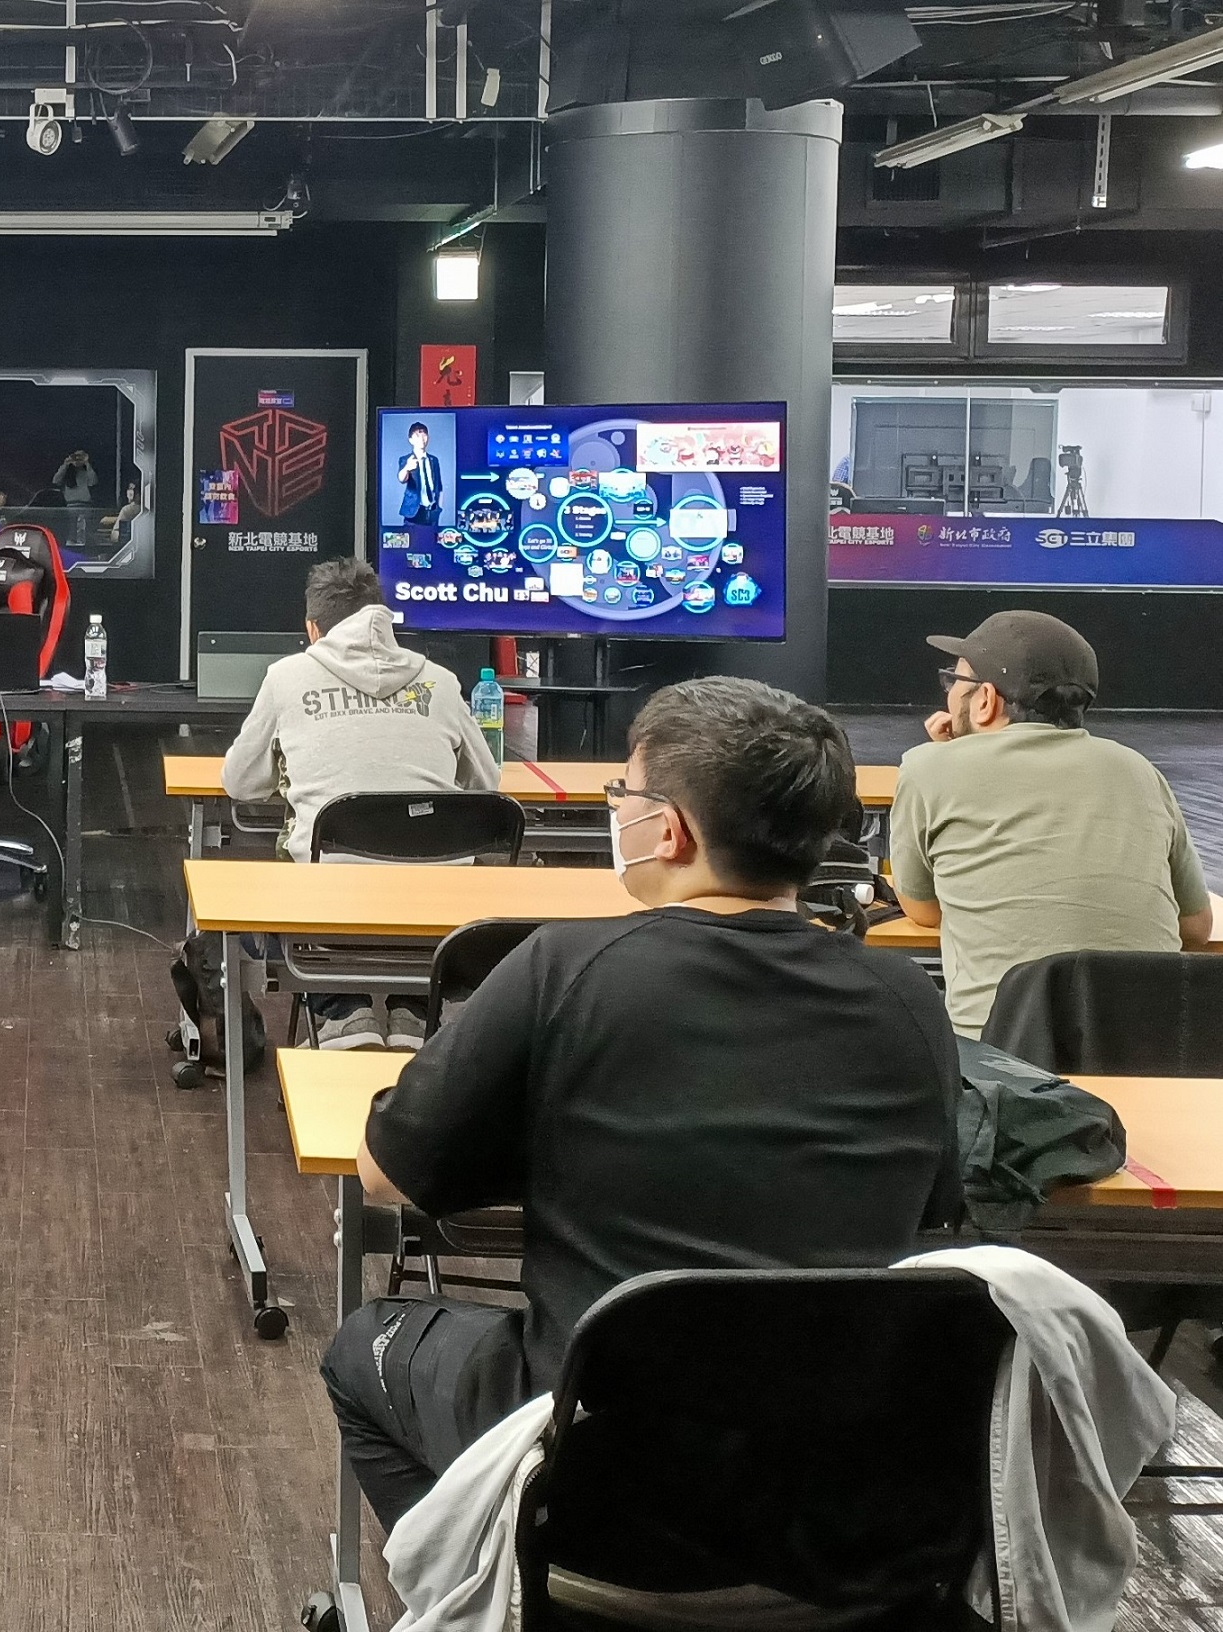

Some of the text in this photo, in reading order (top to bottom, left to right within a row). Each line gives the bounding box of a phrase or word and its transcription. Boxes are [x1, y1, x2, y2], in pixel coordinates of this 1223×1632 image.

[228, 531, 319, 547] 新北電競基地
[938, 526, 1012, 542] 新北市政府
[1070, 531, 1135, 547] 三立集團
[395, 582, 509, 602] Scott Chu
